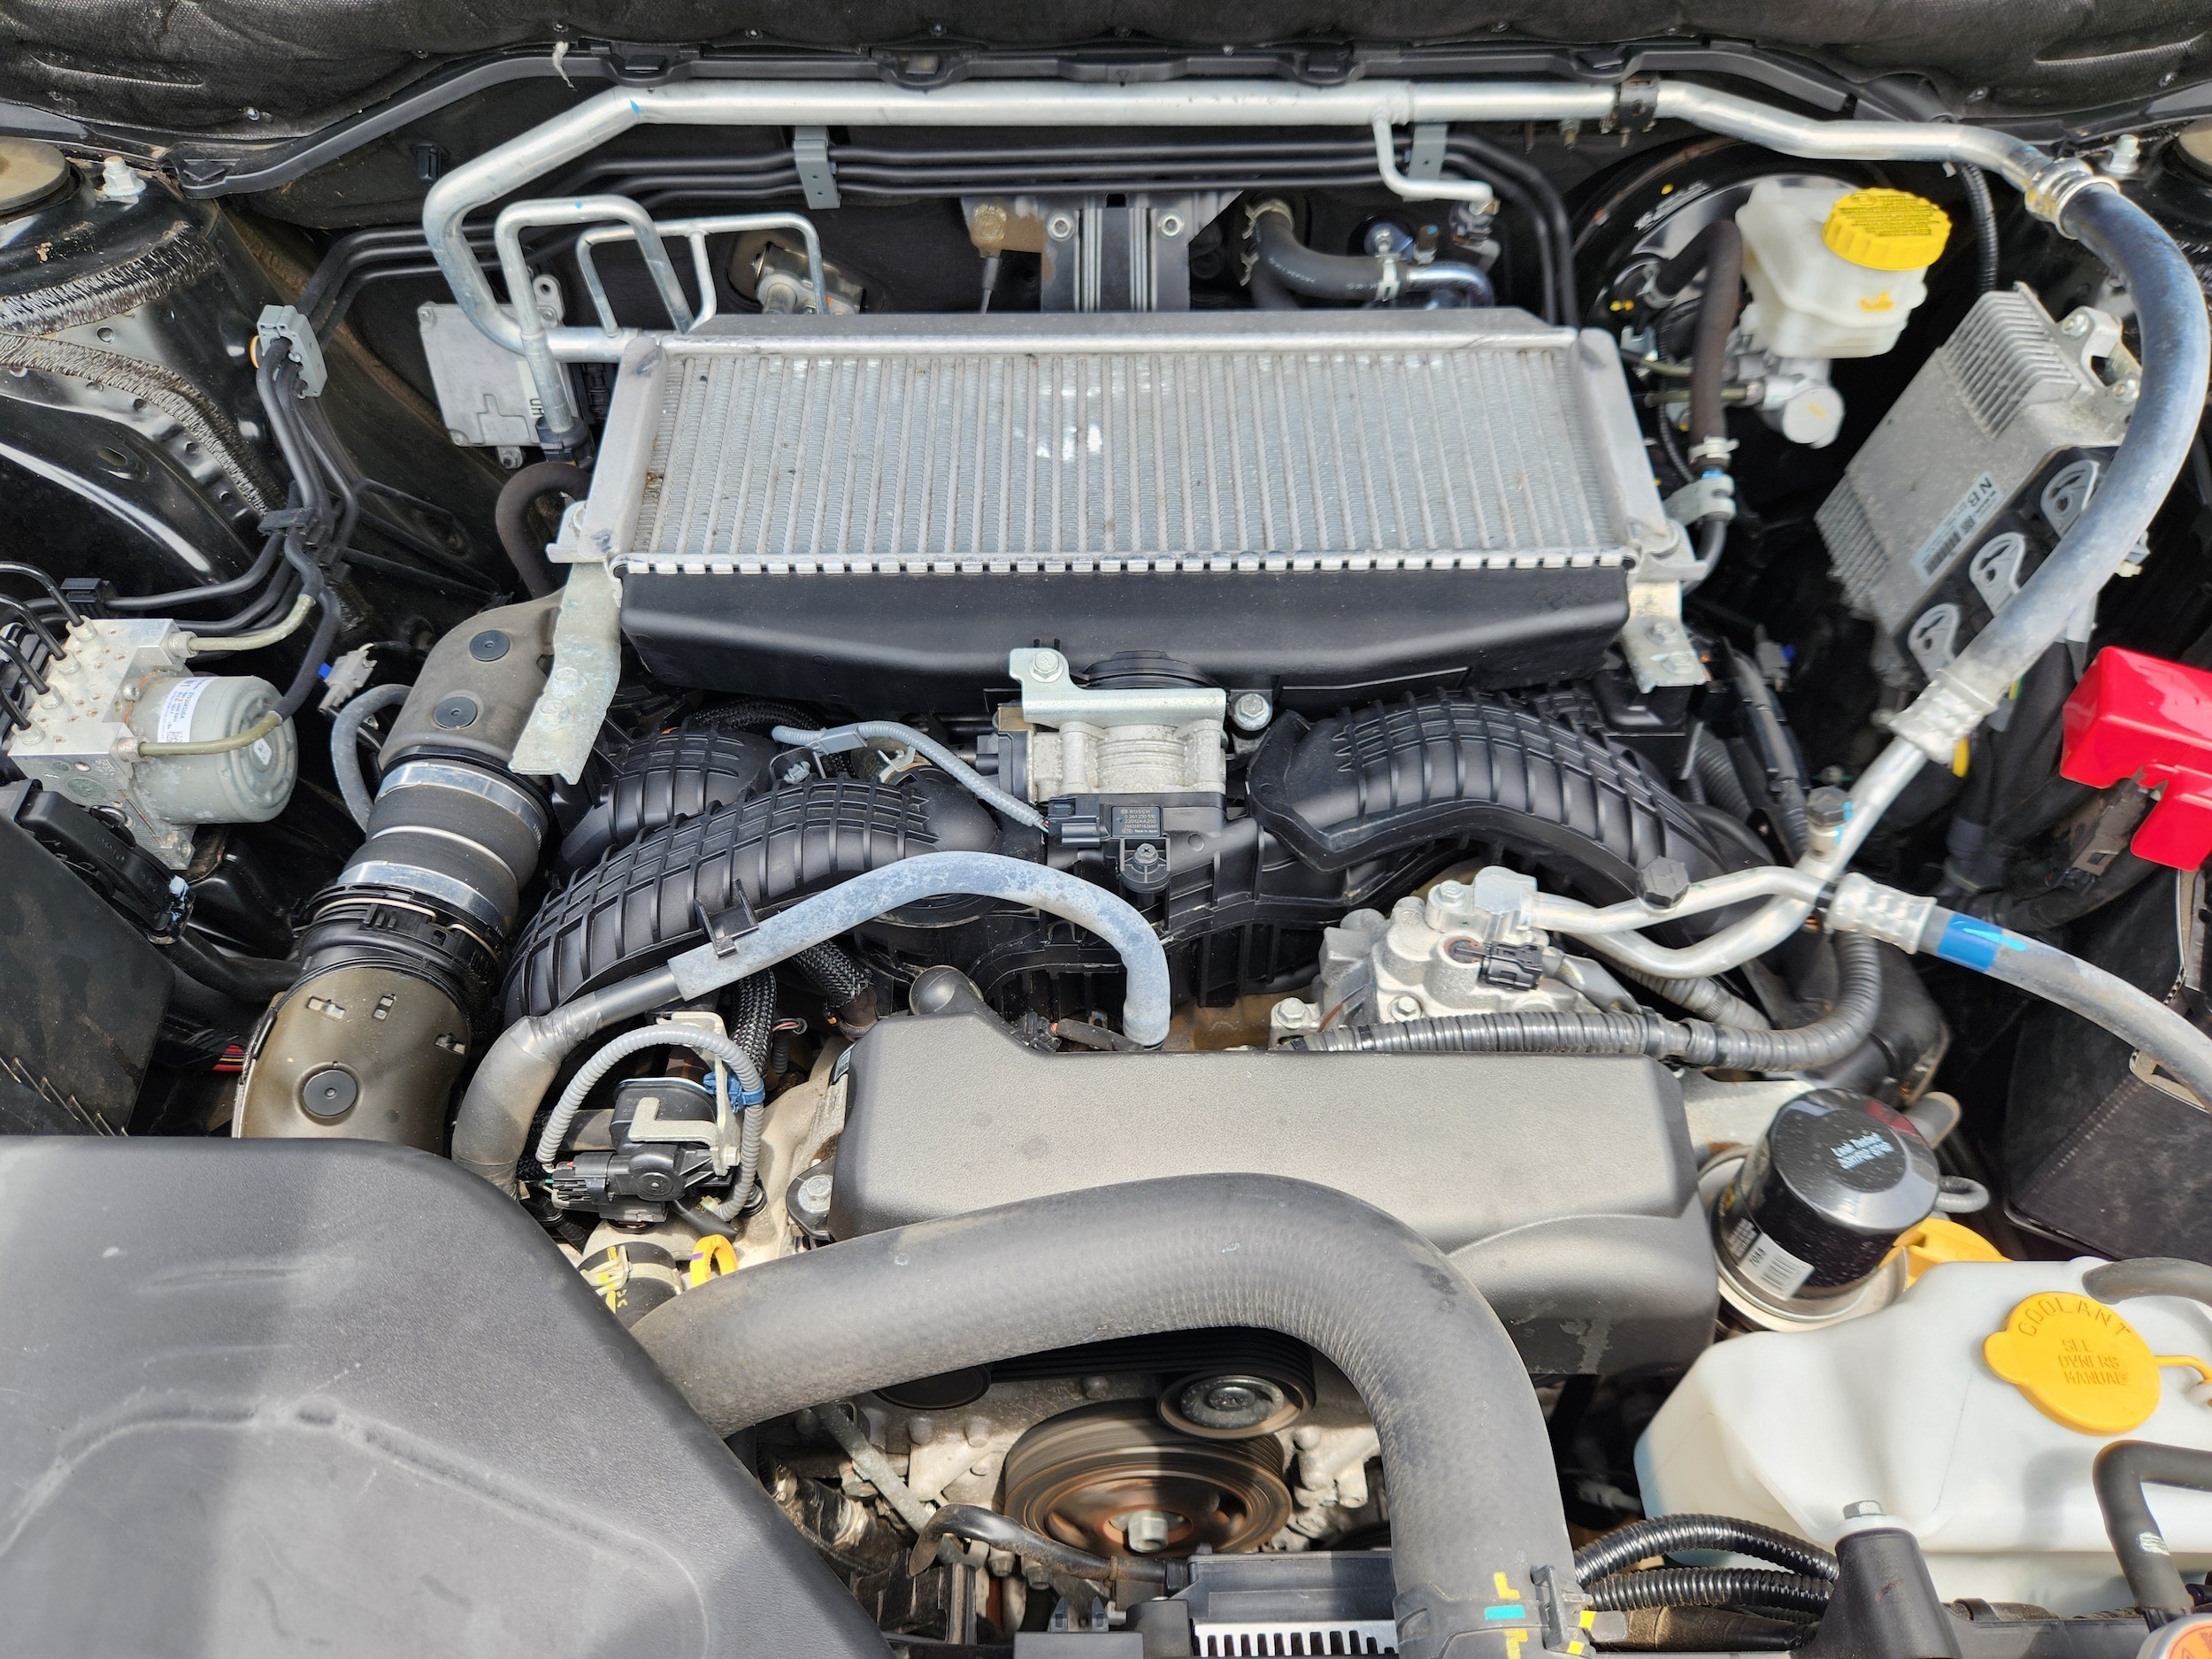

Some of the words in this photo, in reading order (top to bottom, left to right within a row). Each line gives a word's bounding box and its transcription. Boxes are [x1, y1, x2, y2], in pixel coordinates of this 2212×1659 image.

[2018, 1296, 2131, 1337] COOLANT
[2062, 1338, 2093, 1353] SEE
[2063, 1371, 2127, 1386] MANUAL
